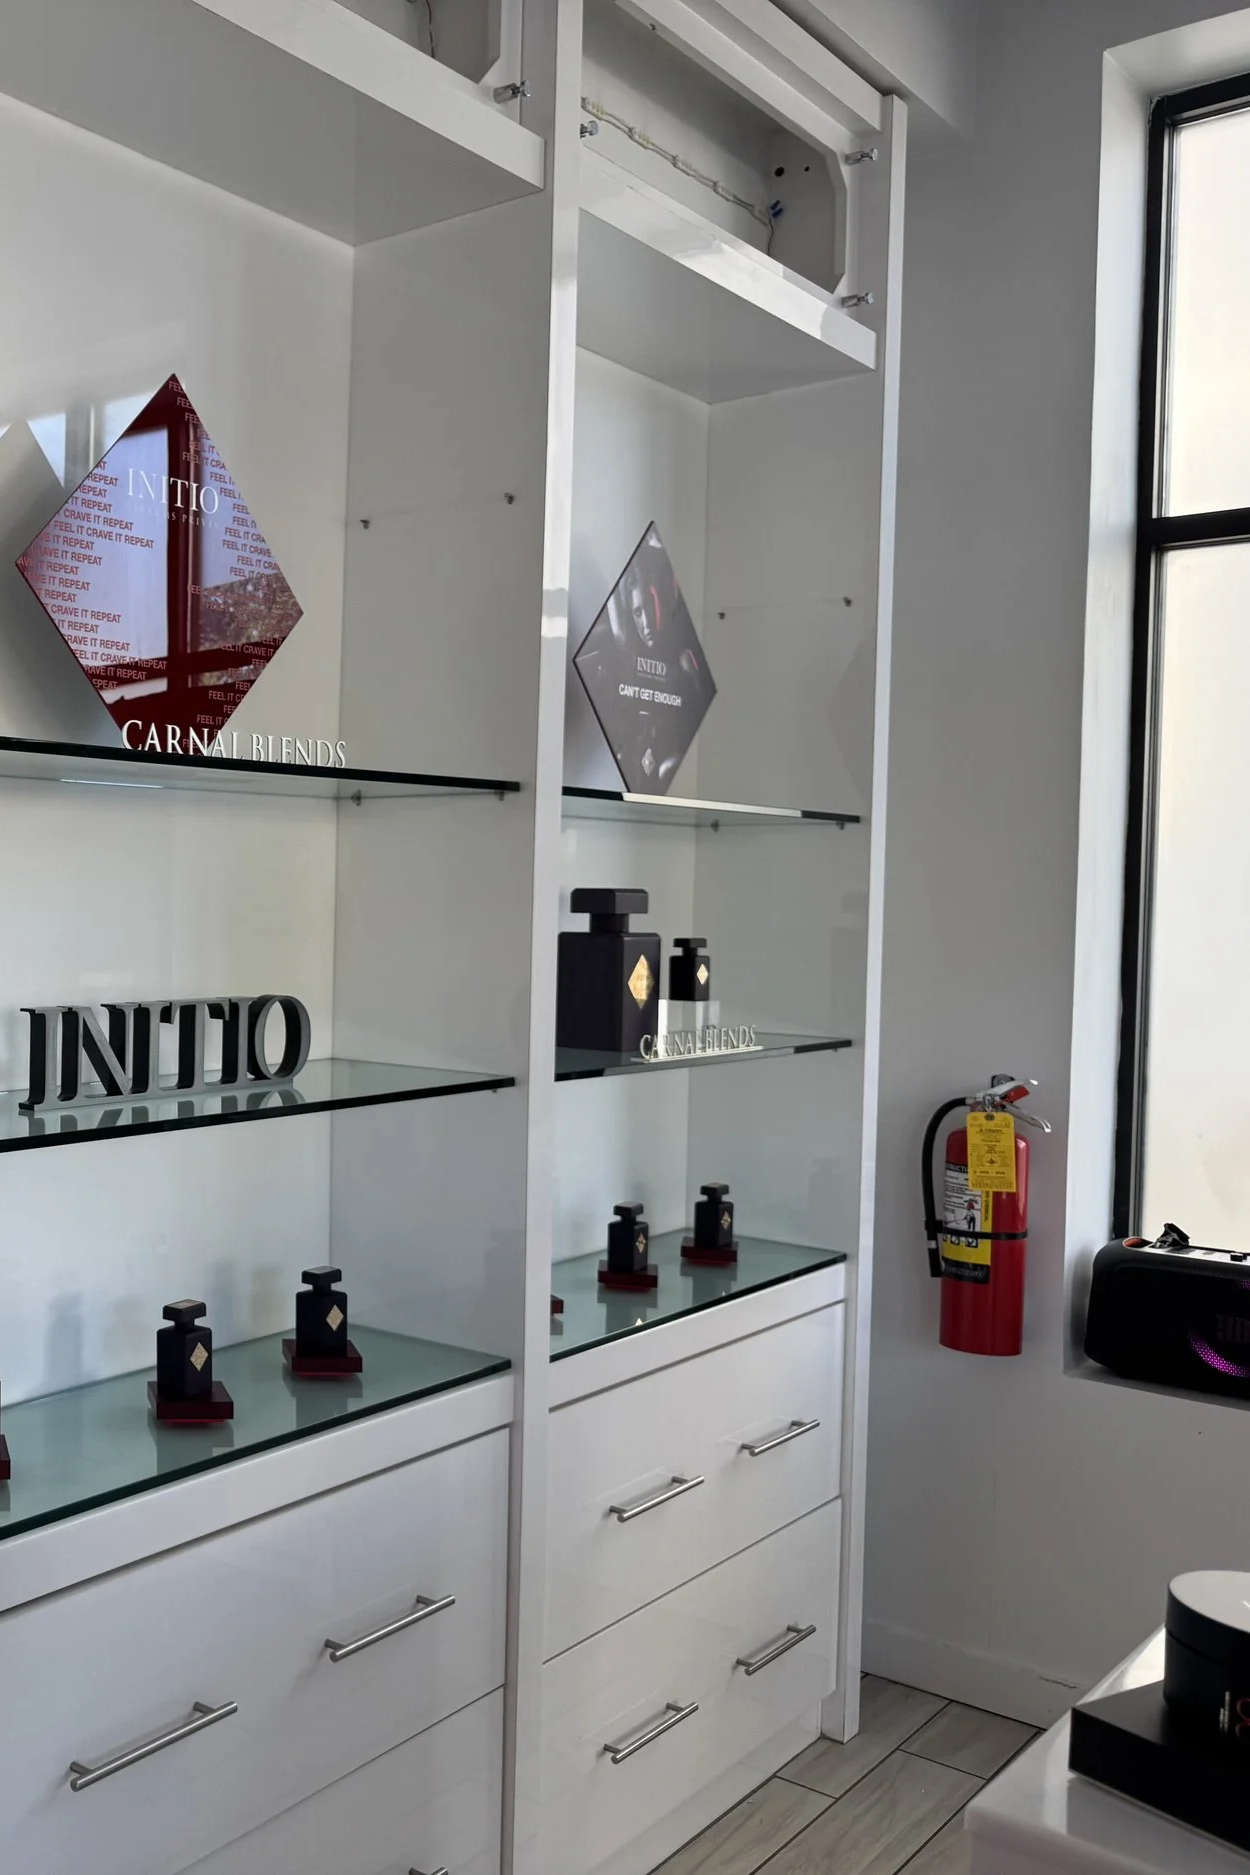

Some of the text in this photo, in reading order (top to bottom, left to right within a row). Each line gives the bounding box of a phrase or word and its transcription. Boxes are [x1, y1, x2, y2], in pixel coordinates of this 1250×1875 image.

[177, 396, 192, 409] FEE
[184, 412, 199, 424] FEE
[210, 459, 226, 471] CRA
[210, 472, 228, 485] FEEL
[126, 467, 219, 515] INITIO
[220, 487, 238, 499] FEEL
[71, 496, 113, 513] IT REPEAT
[63, 509, 134, 532] CRAVE IT REPEAT
[232, 516, 250, 528] FEEL
[53, 521, 155, 549] FEEL IT CRAVE IT REPEAT
[225, 527, 267, 544] FEEL IT CRA
[52, 535, 61, 545] IT
[62, 536, 95, 551] REPEAT
[222, 539, 240, 551] FEEL
[241, 543, 248, 553] IT
[61, 550, 69, 560] IT
[71, 551, 102, 566] REPEAT
[237, 555, 254, 567] FEEL
[255, 559, 262, 568] IT
[46, 561, 79, 575] REPEAT
[230, 566, 247, 578] FEEL
[48, 575, 56, 586] IT
[58, 577, 91, 592] REPEAT
[44, 590, 77, 603] REPEAT
[51, 604, 79, 617] CRAVE
[80, 608, 89, 618] IT
[90, 610, 122, 623] REPEAT
[58, 619, 100, 634] IT REPEAT
[90, 637, 98, 647] IT
[100, 639, 130, 652] REPEAT
[243, 645, 266, 657] CRAVE
[267, 648, 274, 657] IT
[90, 652, 99, 660] IT
[100, 653, 127, 665] CRAVE
[128, 657, 137, 666] IT
[138, 658, 168, 670] REPEAT
[637, 656, 667, 676] INITIO
[107, 667, 115, 677] IT
[116, 669, 147, 680] REPEAT
[92, 678, 118, 689] EPEAT
[208, 690, 226, 701] FEEL
[227, 693, 234, 702] IT
[640, 688, 654, 701] GET
[654, 690, 682, 707] ENOUGH
[196, 714, 215, 725] FEEL
[215, 716, 223, 726] IT
[121, 719, 347, 769] CARNAL BLENDS
[705, 1024, 756, 1051] BLENDS
[18, 994, 311, 1111] INITIO
